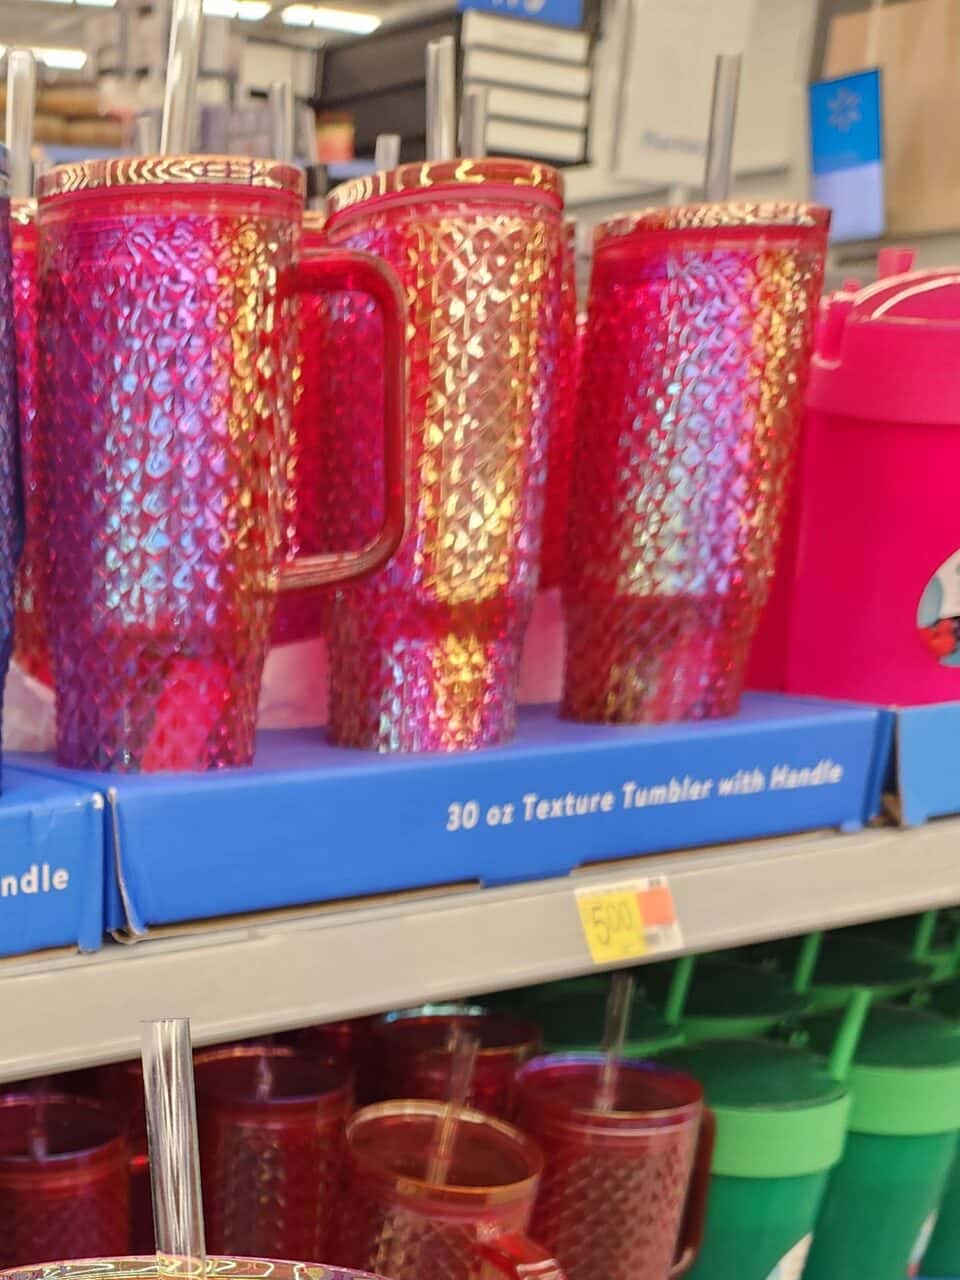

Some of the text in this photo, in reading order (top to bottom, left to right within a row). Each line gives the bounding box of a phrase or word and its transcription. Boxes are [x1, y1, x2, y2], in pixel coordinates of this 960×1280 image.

[446, 758, 843, 832] 30 oz Texture Tumbler with Handle
